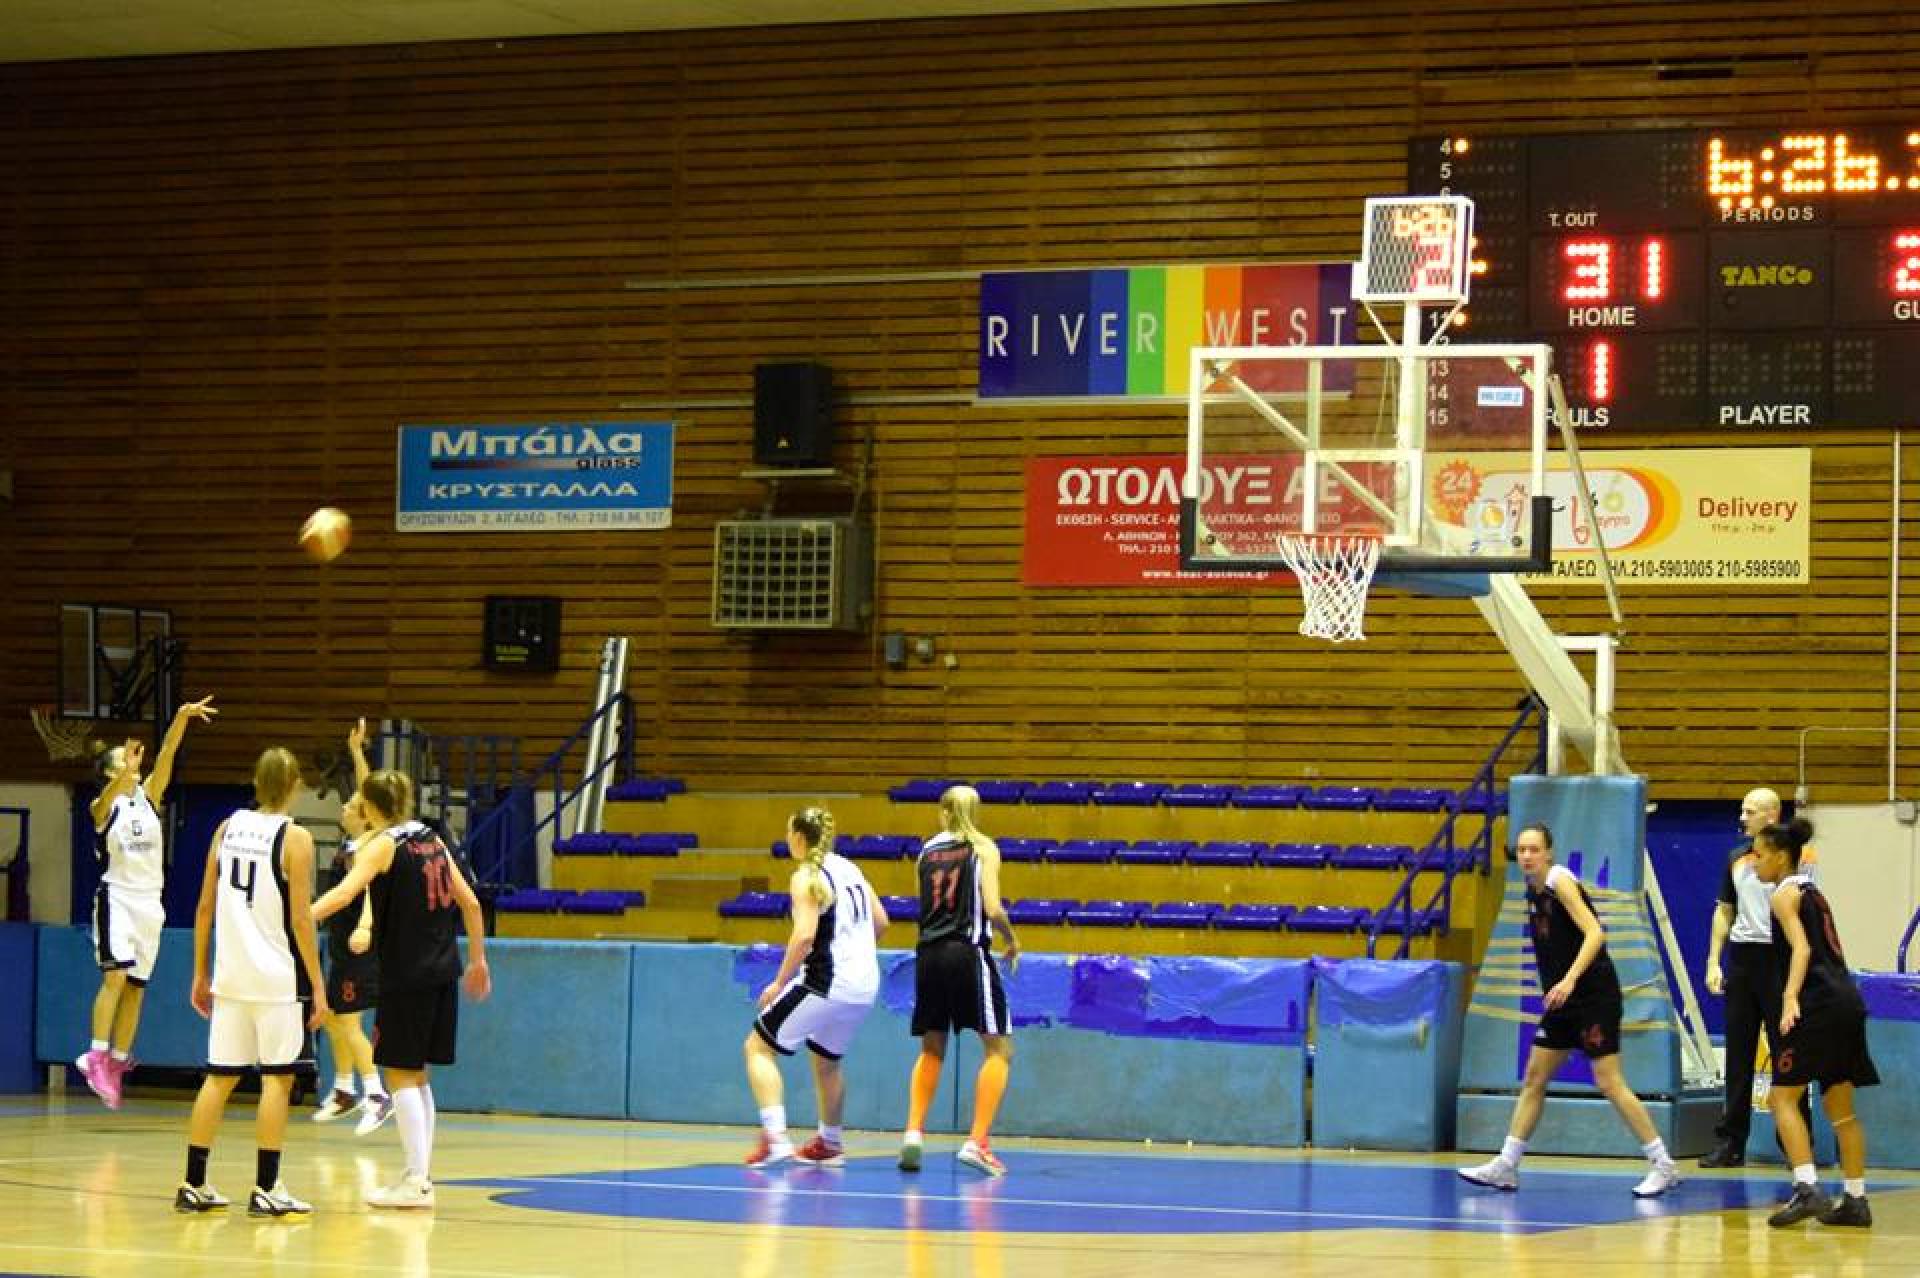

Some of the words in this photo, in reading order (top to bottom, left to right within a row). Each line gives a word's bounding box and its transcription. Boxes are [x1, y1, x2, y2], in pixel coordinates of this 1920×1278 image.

[1439, 137, 1452, 155] 4
[1440, 162, 1453, 179] 5
[1564, 211, 1599, 228] OUT
[1720, 206, 1815, 224] PERIODS
[1565, 241, 1662, 299] 31
[1567, 306, 1637, 327] HOME
[987, 310, 1161, 358] RIVER
[1204, 306, 1347, 347] WEST
[1429, 359, 1450, 377] 13
[1592, 342, 1611, 401] 1
[1429, 383, 1450, 401] 14
[1429, 407, 1450, 425] 15
[1719, 405, 1811, 425] PLAYER
[430, 427, 643, 457] Μπάιλα
[576, 455, 641, 471] glass
[429, 481, 639, 499] ΚΡΥΣΤΑΛΛΑ
[1057, 466, 1273, 506] ΩΤΟΛΟΥΞ
[1442, 472, 1472, 495] 24
[1699, 497, 1798, 523] Delivery
[1110, 513, 1161, 526] SERVICE
[1717, 560, 1800, 577] 210-5985900
[230, 856, 257, 909] 4
